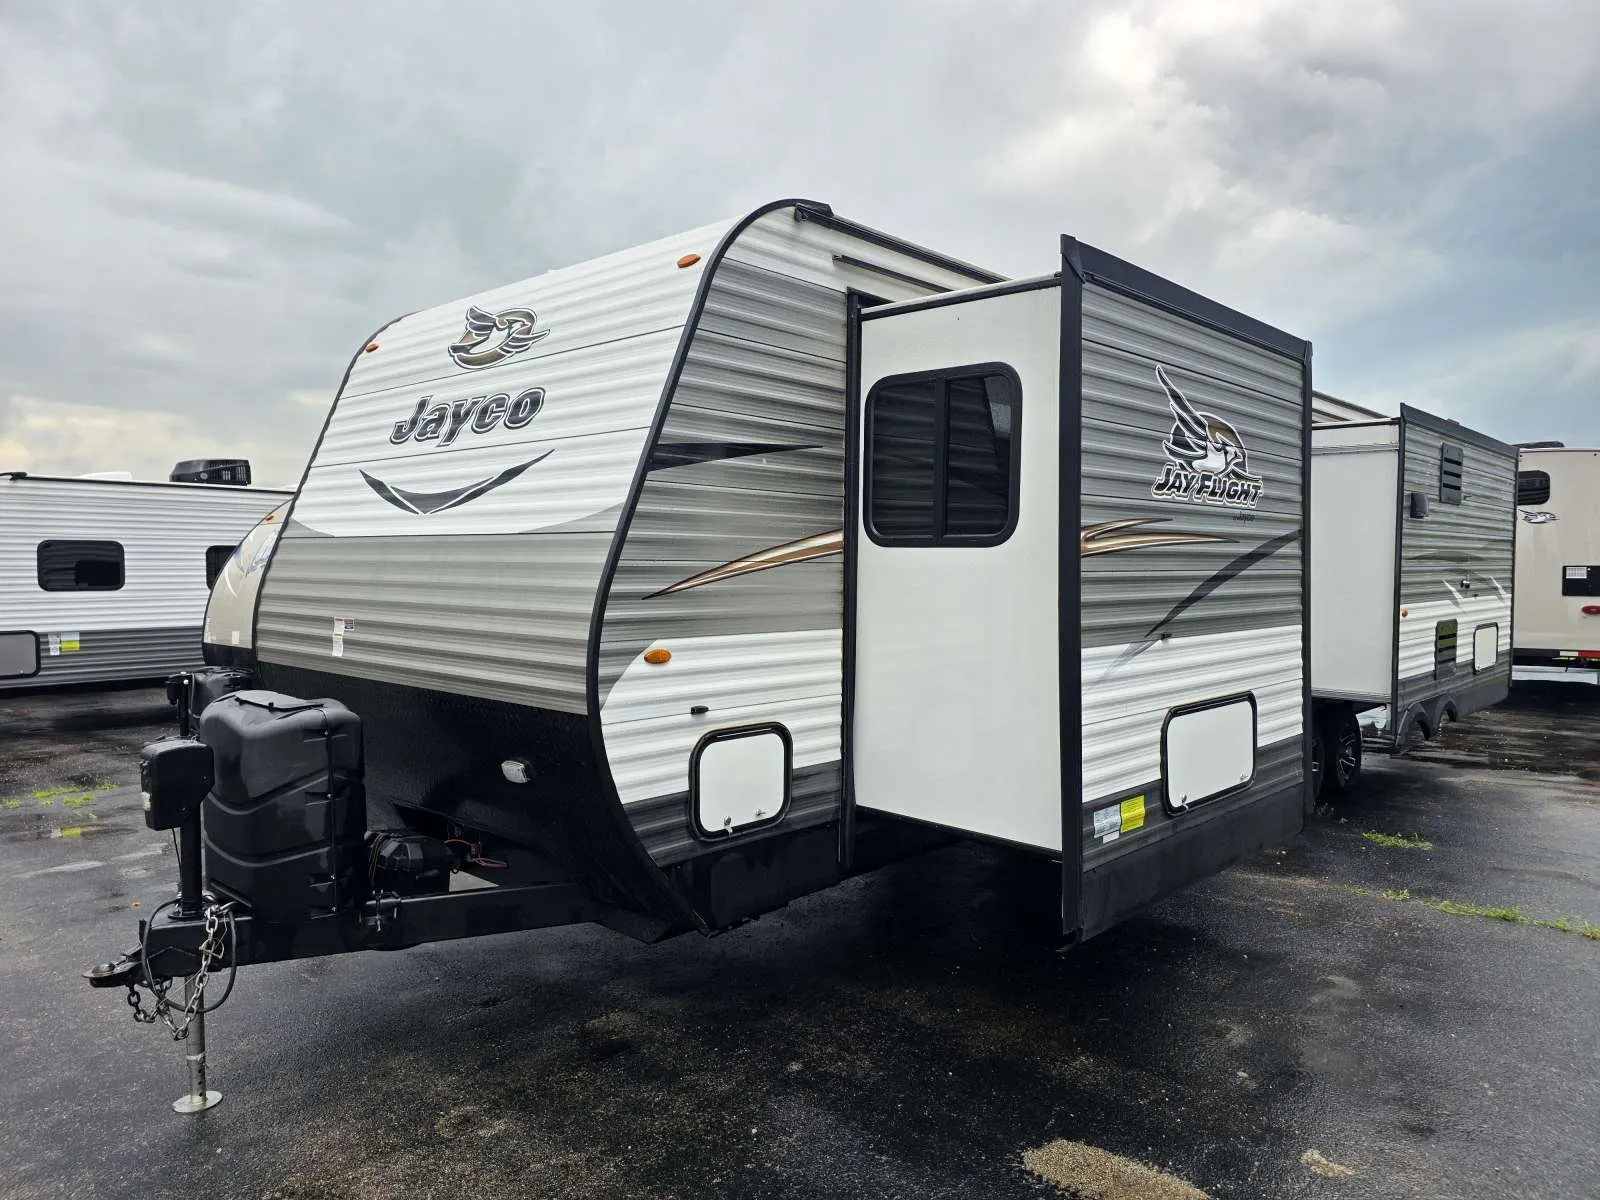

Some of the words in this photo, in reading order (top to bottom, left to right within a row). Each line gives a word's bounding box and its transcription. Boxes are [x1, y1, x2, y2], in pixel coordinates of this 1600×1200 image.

[390, 387, 545, 447] Jayco
[1152, 463, 1198, 499] JAY
[1194, 472, 1263, 507] FLIGHT
